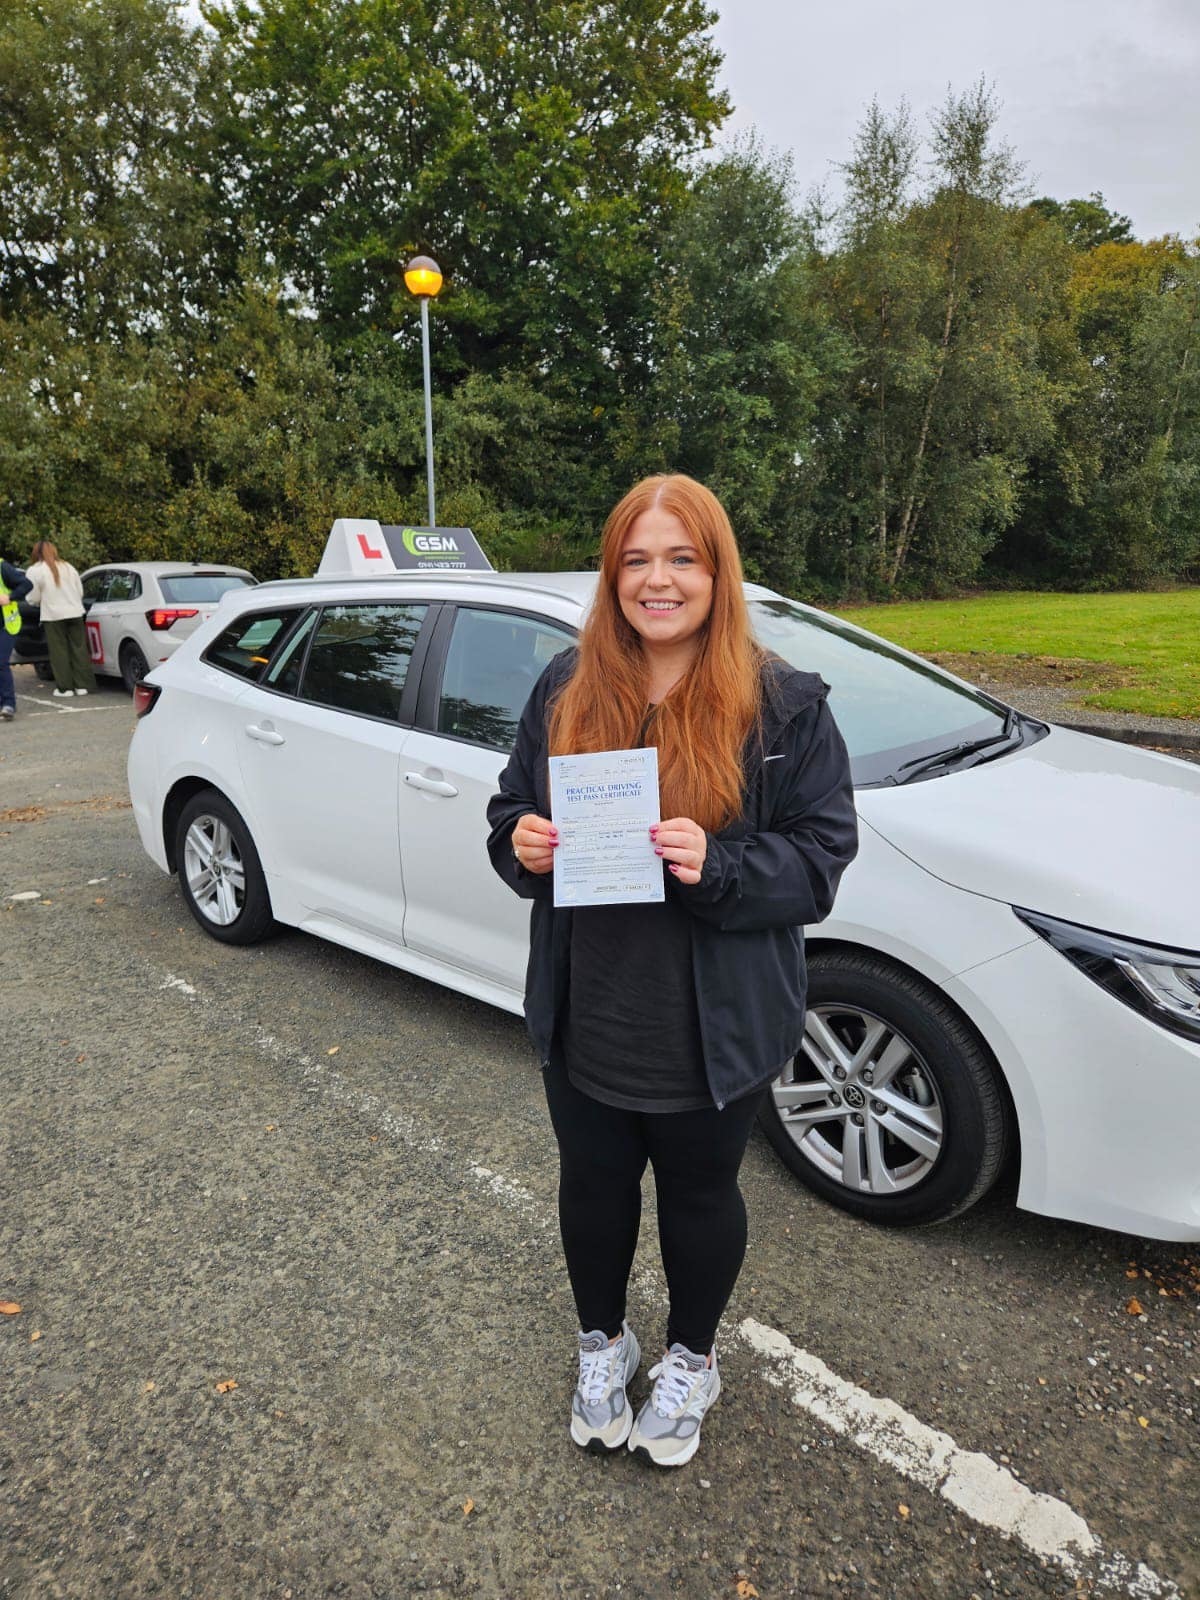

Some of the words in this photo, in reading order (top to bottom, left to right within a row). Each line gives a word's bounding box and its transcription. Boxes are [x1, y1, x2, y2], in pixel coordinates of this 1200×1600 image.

[357, 534, 382, 558] L
[415, 536, 458, 551] GSM
[566, 785, 605, 795] PRACTICAL
[607, 782, 642, 791] DRIVING
[567, 795, 582, 803] TEST
[600, 789, 641, 799] CERTIFICATE
